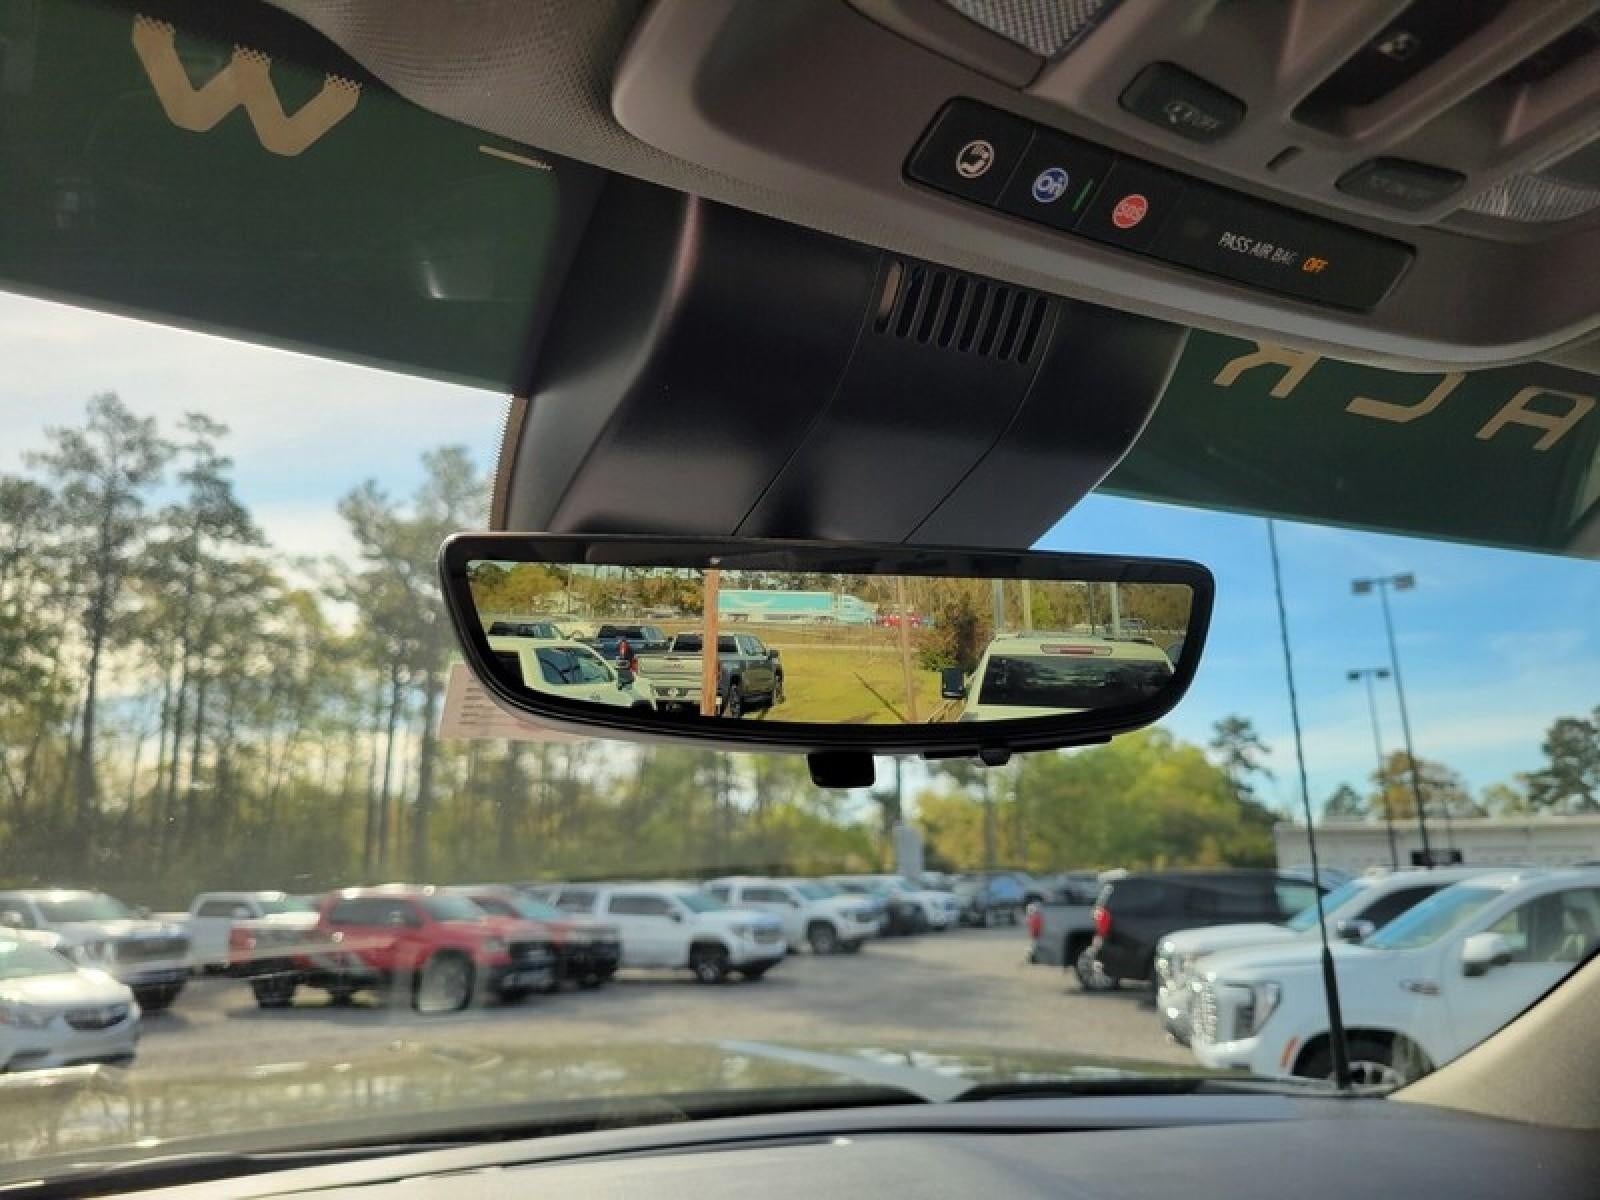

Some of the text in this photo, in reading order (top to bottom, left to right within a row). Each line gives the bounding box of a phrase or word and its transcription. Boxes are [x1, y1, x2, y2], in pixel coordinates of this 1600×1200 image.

[1218, 231, 1252, 253] PASS
[1249, 242, 1274, 259] AIR
[1302, 256, 1329, 273] OFF
